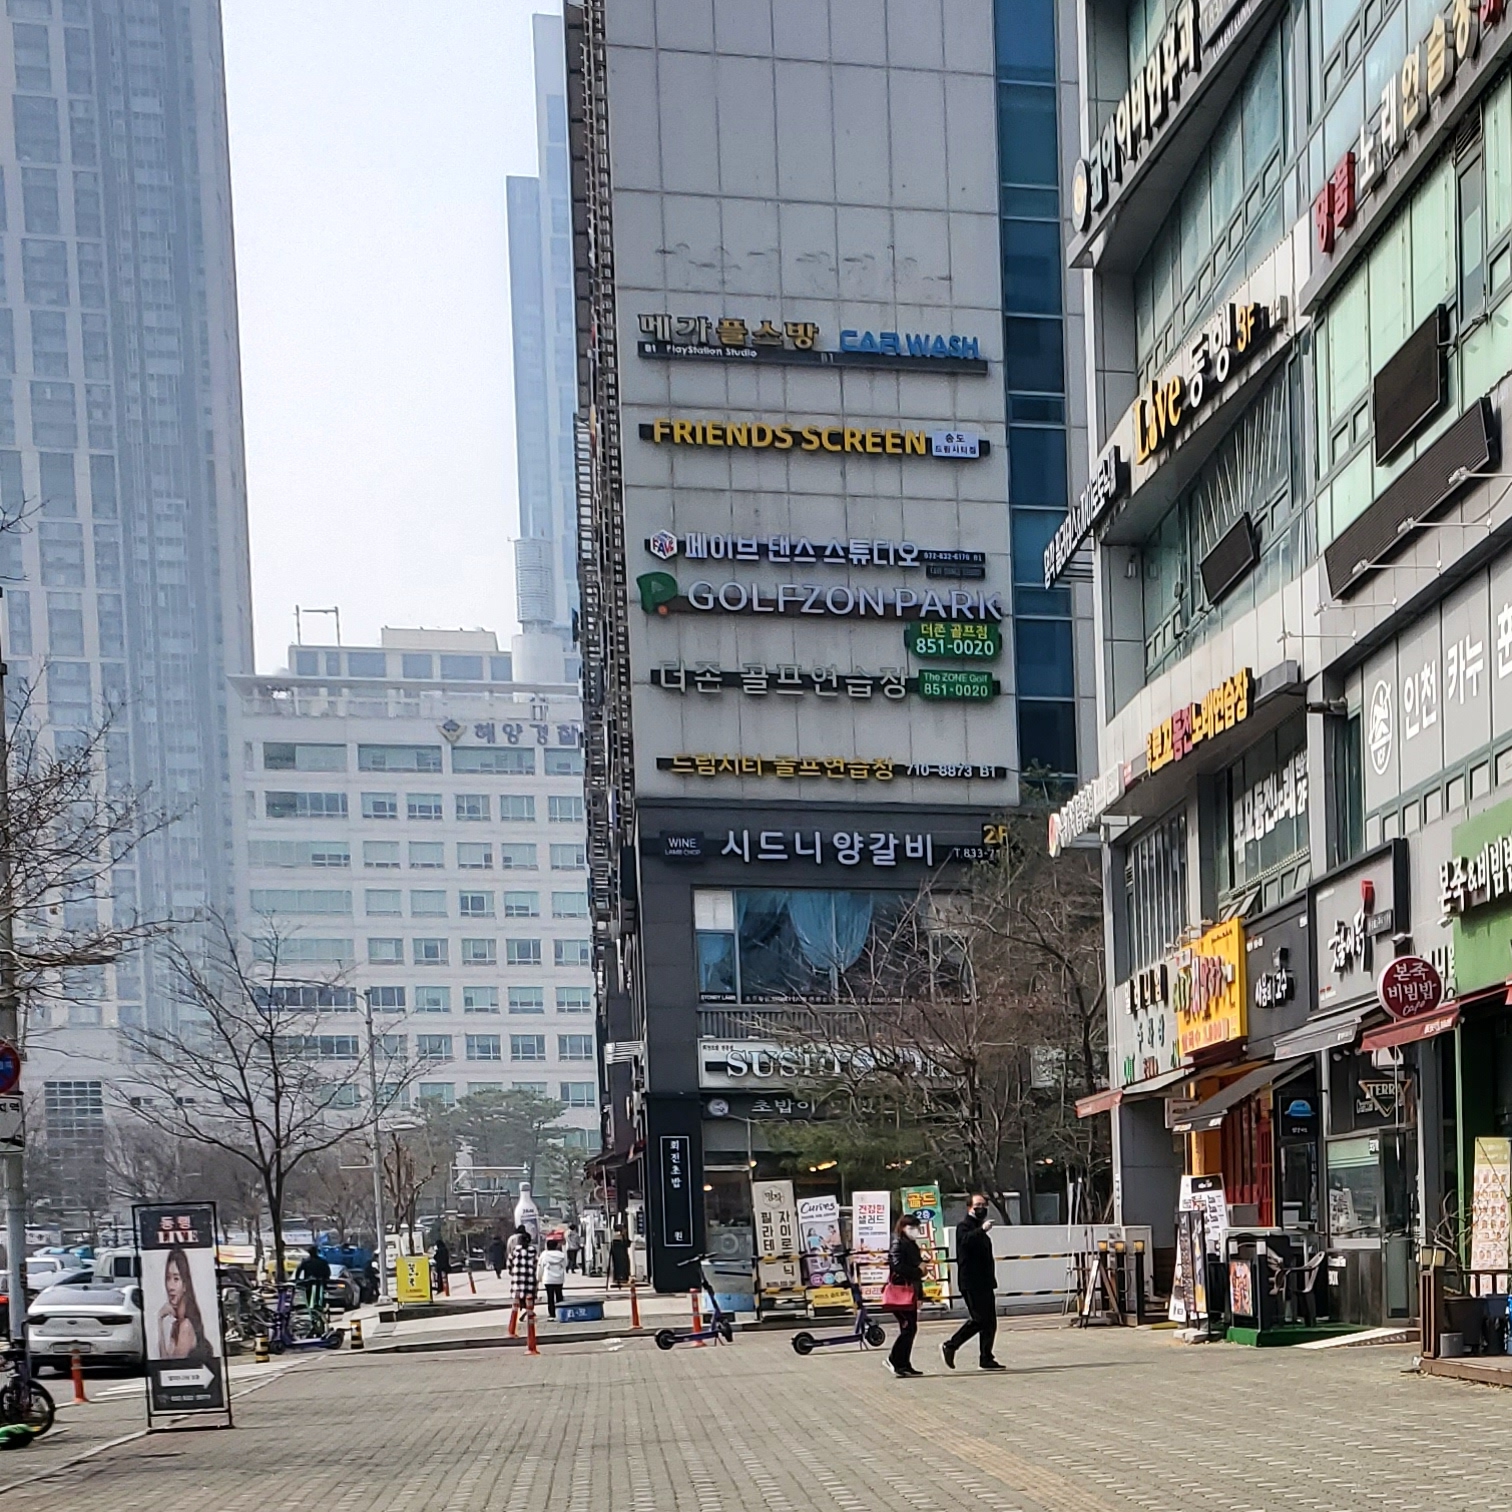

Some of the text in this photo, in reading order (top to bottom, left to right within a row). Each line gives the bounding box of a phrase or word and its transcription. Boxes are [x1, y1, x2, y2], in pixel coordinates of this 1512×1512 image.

[638, 313, 979, 359] 메가플스방 CAR WASH
[1188, 303, 1232, 408] 동행
[1237, 304, 1255, 352] 3F
[653, 418, 927, 456] FRIENDS SCREEN
[944, 432, 966, 444] 송도
[684, 533, 921, 567] 페이브 댄스 스튜디오
[688, 581, 1002, 620] GOLFZON PARK
[920, 622, 988, 639] 더존 골프점
[916, 639, 994, 656] 851-0020
[659, 661, 908, 699] 더존 골프연습장
[1403, 660, 1437, 740] 인천
[1447, 634, 1484, 704] 카누
[924, 684, 988, 698] 851-0020
[671, 753, 763, 776] 드림시티
[773, 755, 896, 780] 골프연습장
[979, 766, 996, 778] B1
[667, 838, 697, 849] WINE
[1393, 962, 1430, 982] 본죽
[1386, 981, 1438, 1003] 비빔밥
[751, 1101, 817, 1116] 초밥이
[800, 1202, 836, 1214] Curves
[907, 1191, 937, 1209] 골드
[159, 1216, 192, 1229] 동행
[156, 1231, 200, 1244] LIVE
